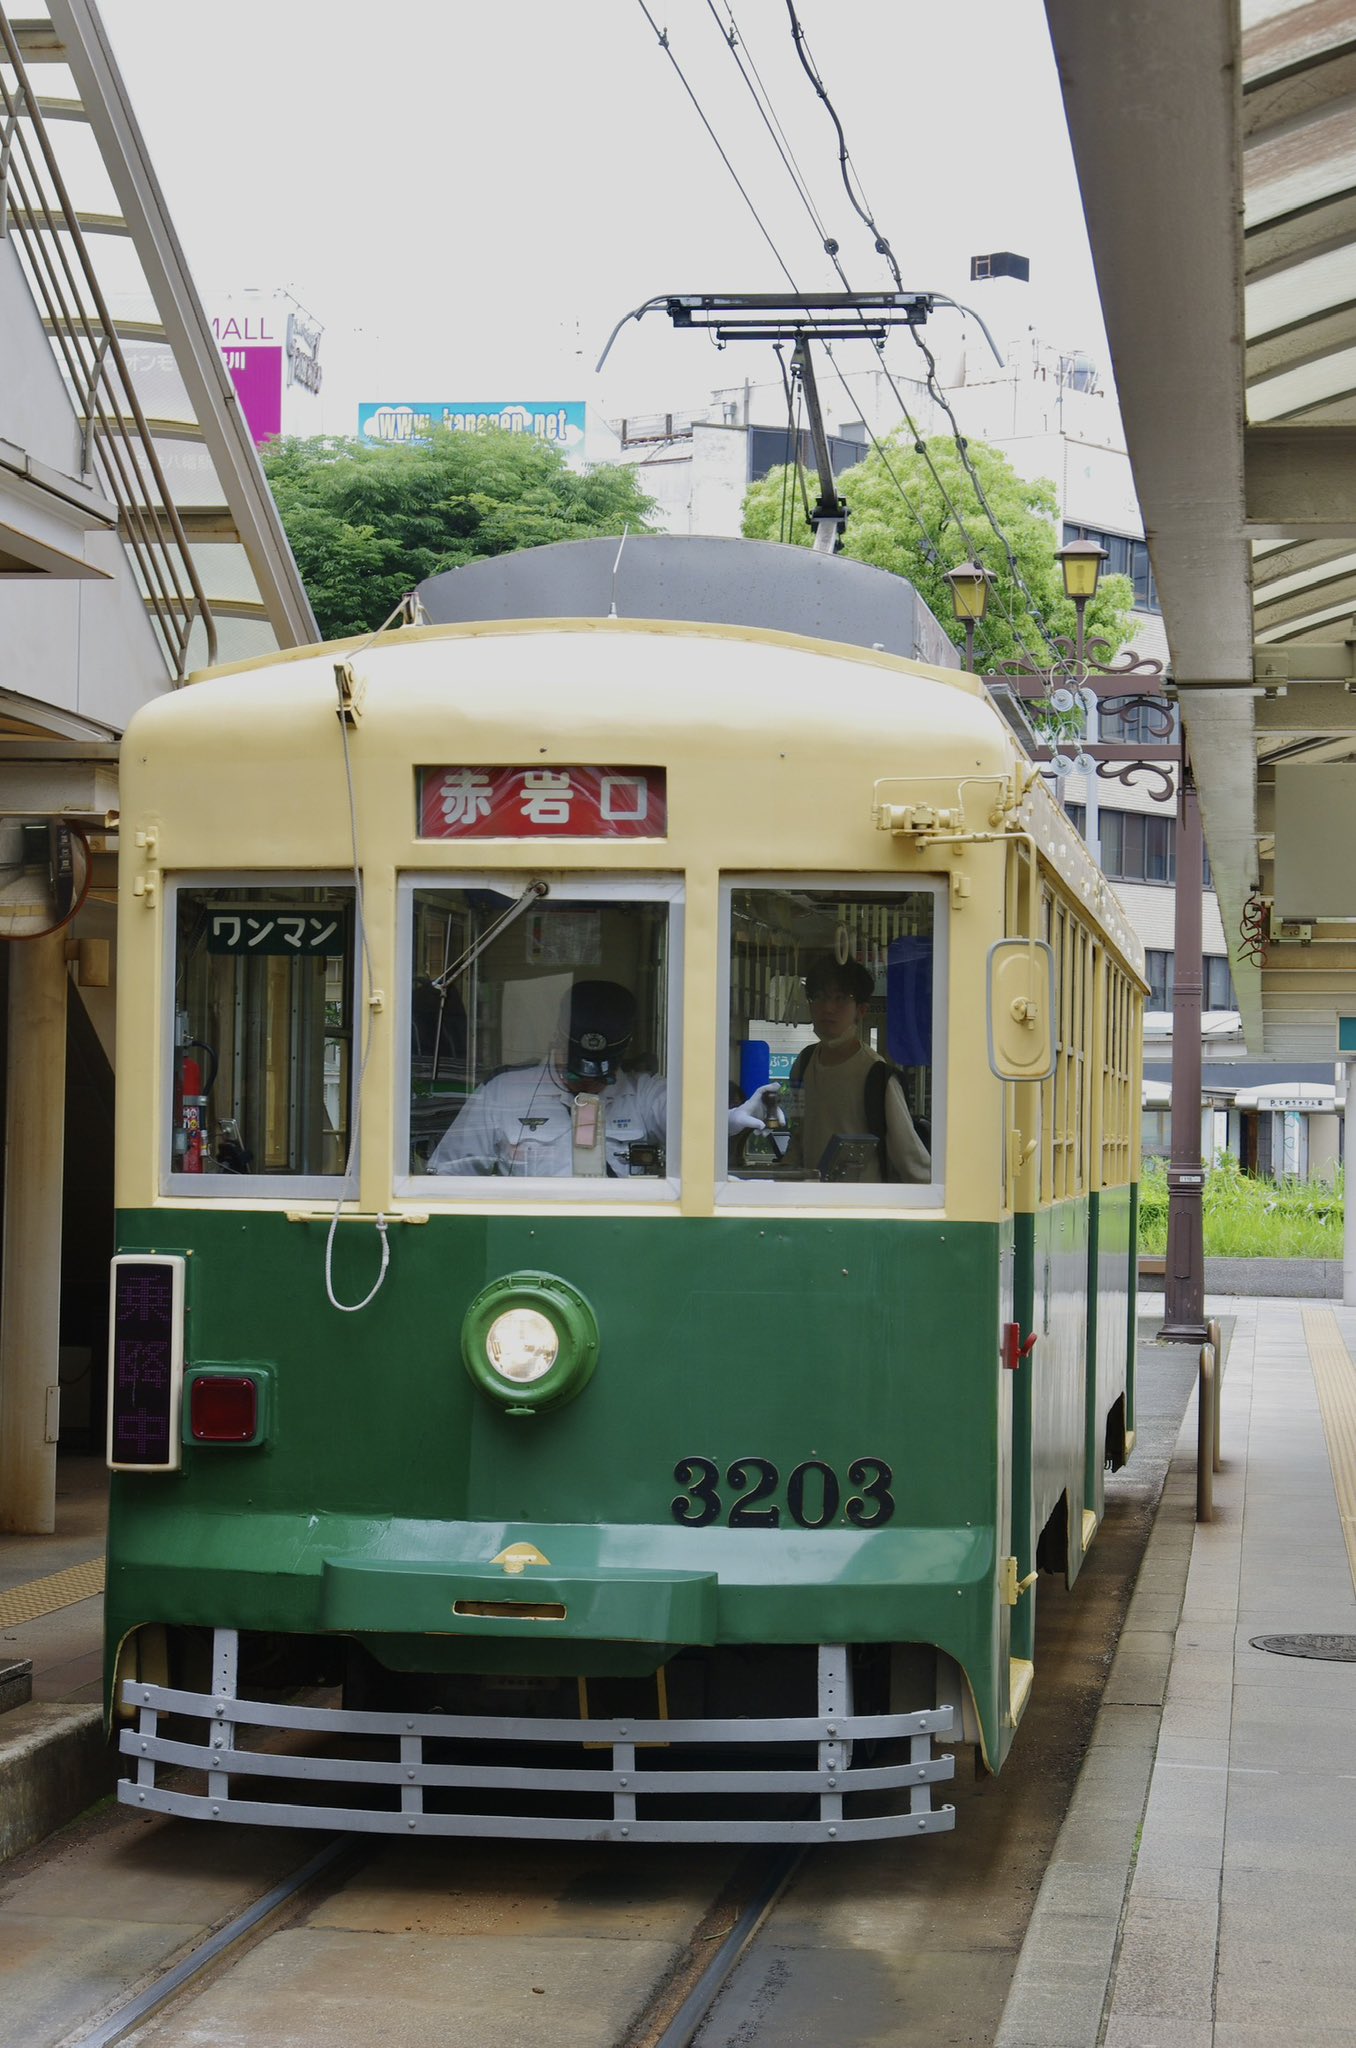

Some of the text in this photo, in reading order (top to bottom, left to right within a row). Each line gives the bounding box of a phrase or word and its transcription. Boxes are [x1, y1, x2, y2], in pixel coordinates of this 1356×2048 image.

[440, 770, 648, 824] 赤岩口
[213, 915, 338, 947] ワンマン
[671, 1455, 896, 1529] 3203
